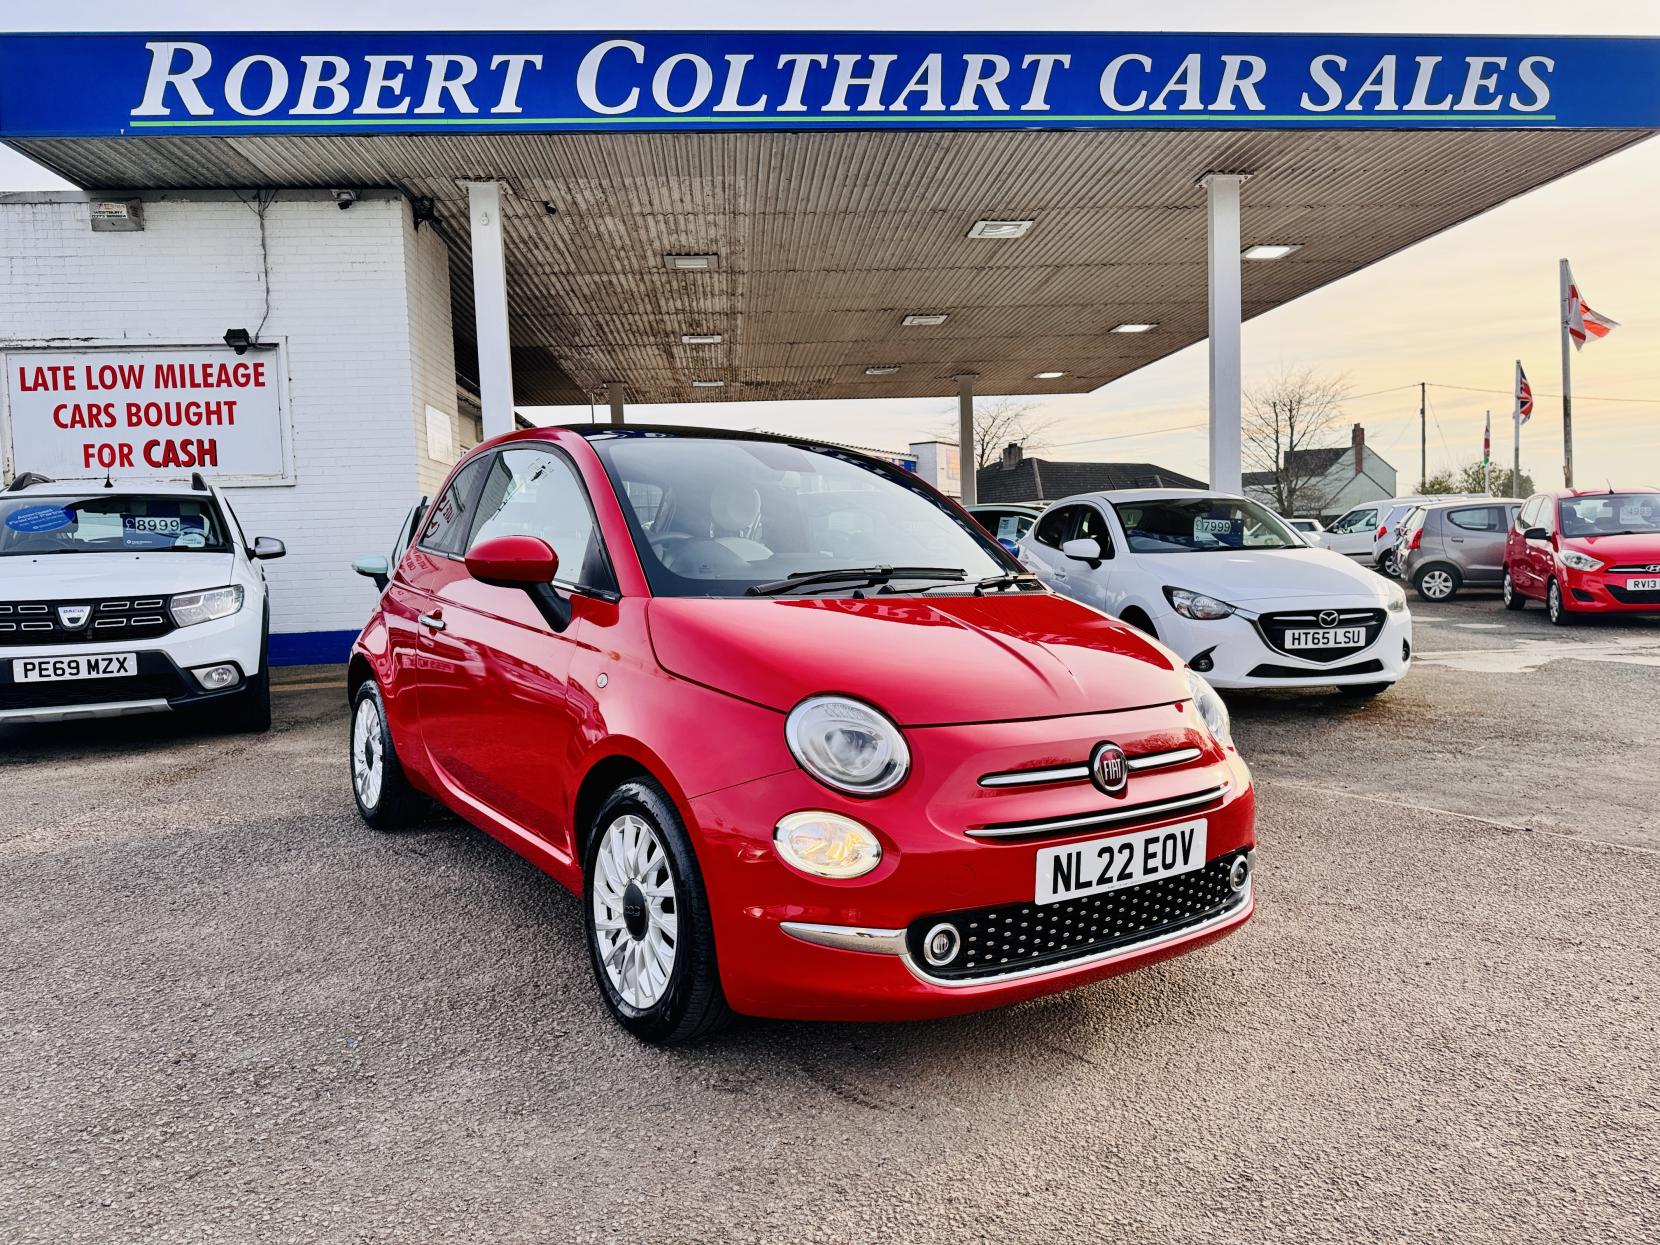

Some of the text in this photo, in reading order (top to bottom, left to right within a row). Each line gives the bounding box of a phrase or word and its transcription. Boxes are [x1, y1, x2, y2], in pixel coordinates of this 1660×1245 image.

[130, 39, 1556, 118] ROBERT COLTHART CAR SALES
[19, 362, 267, 392] LATE LOW MILEAGE
[53, 400, 237, 429] CARS BOUGHT
[83, 438, 218, 469] FOR CASH
[125, 518, 180, 531] £8999
[1633, 580, 1657, 589] RV13
[1291, 630, 1360, 646] HT65 LSU
[23, 656, 129, 679] PE69 MZX
[1103, 758, 1122, 780] FIAT
[1052, 827, 1195, 895] NL22 EOV
